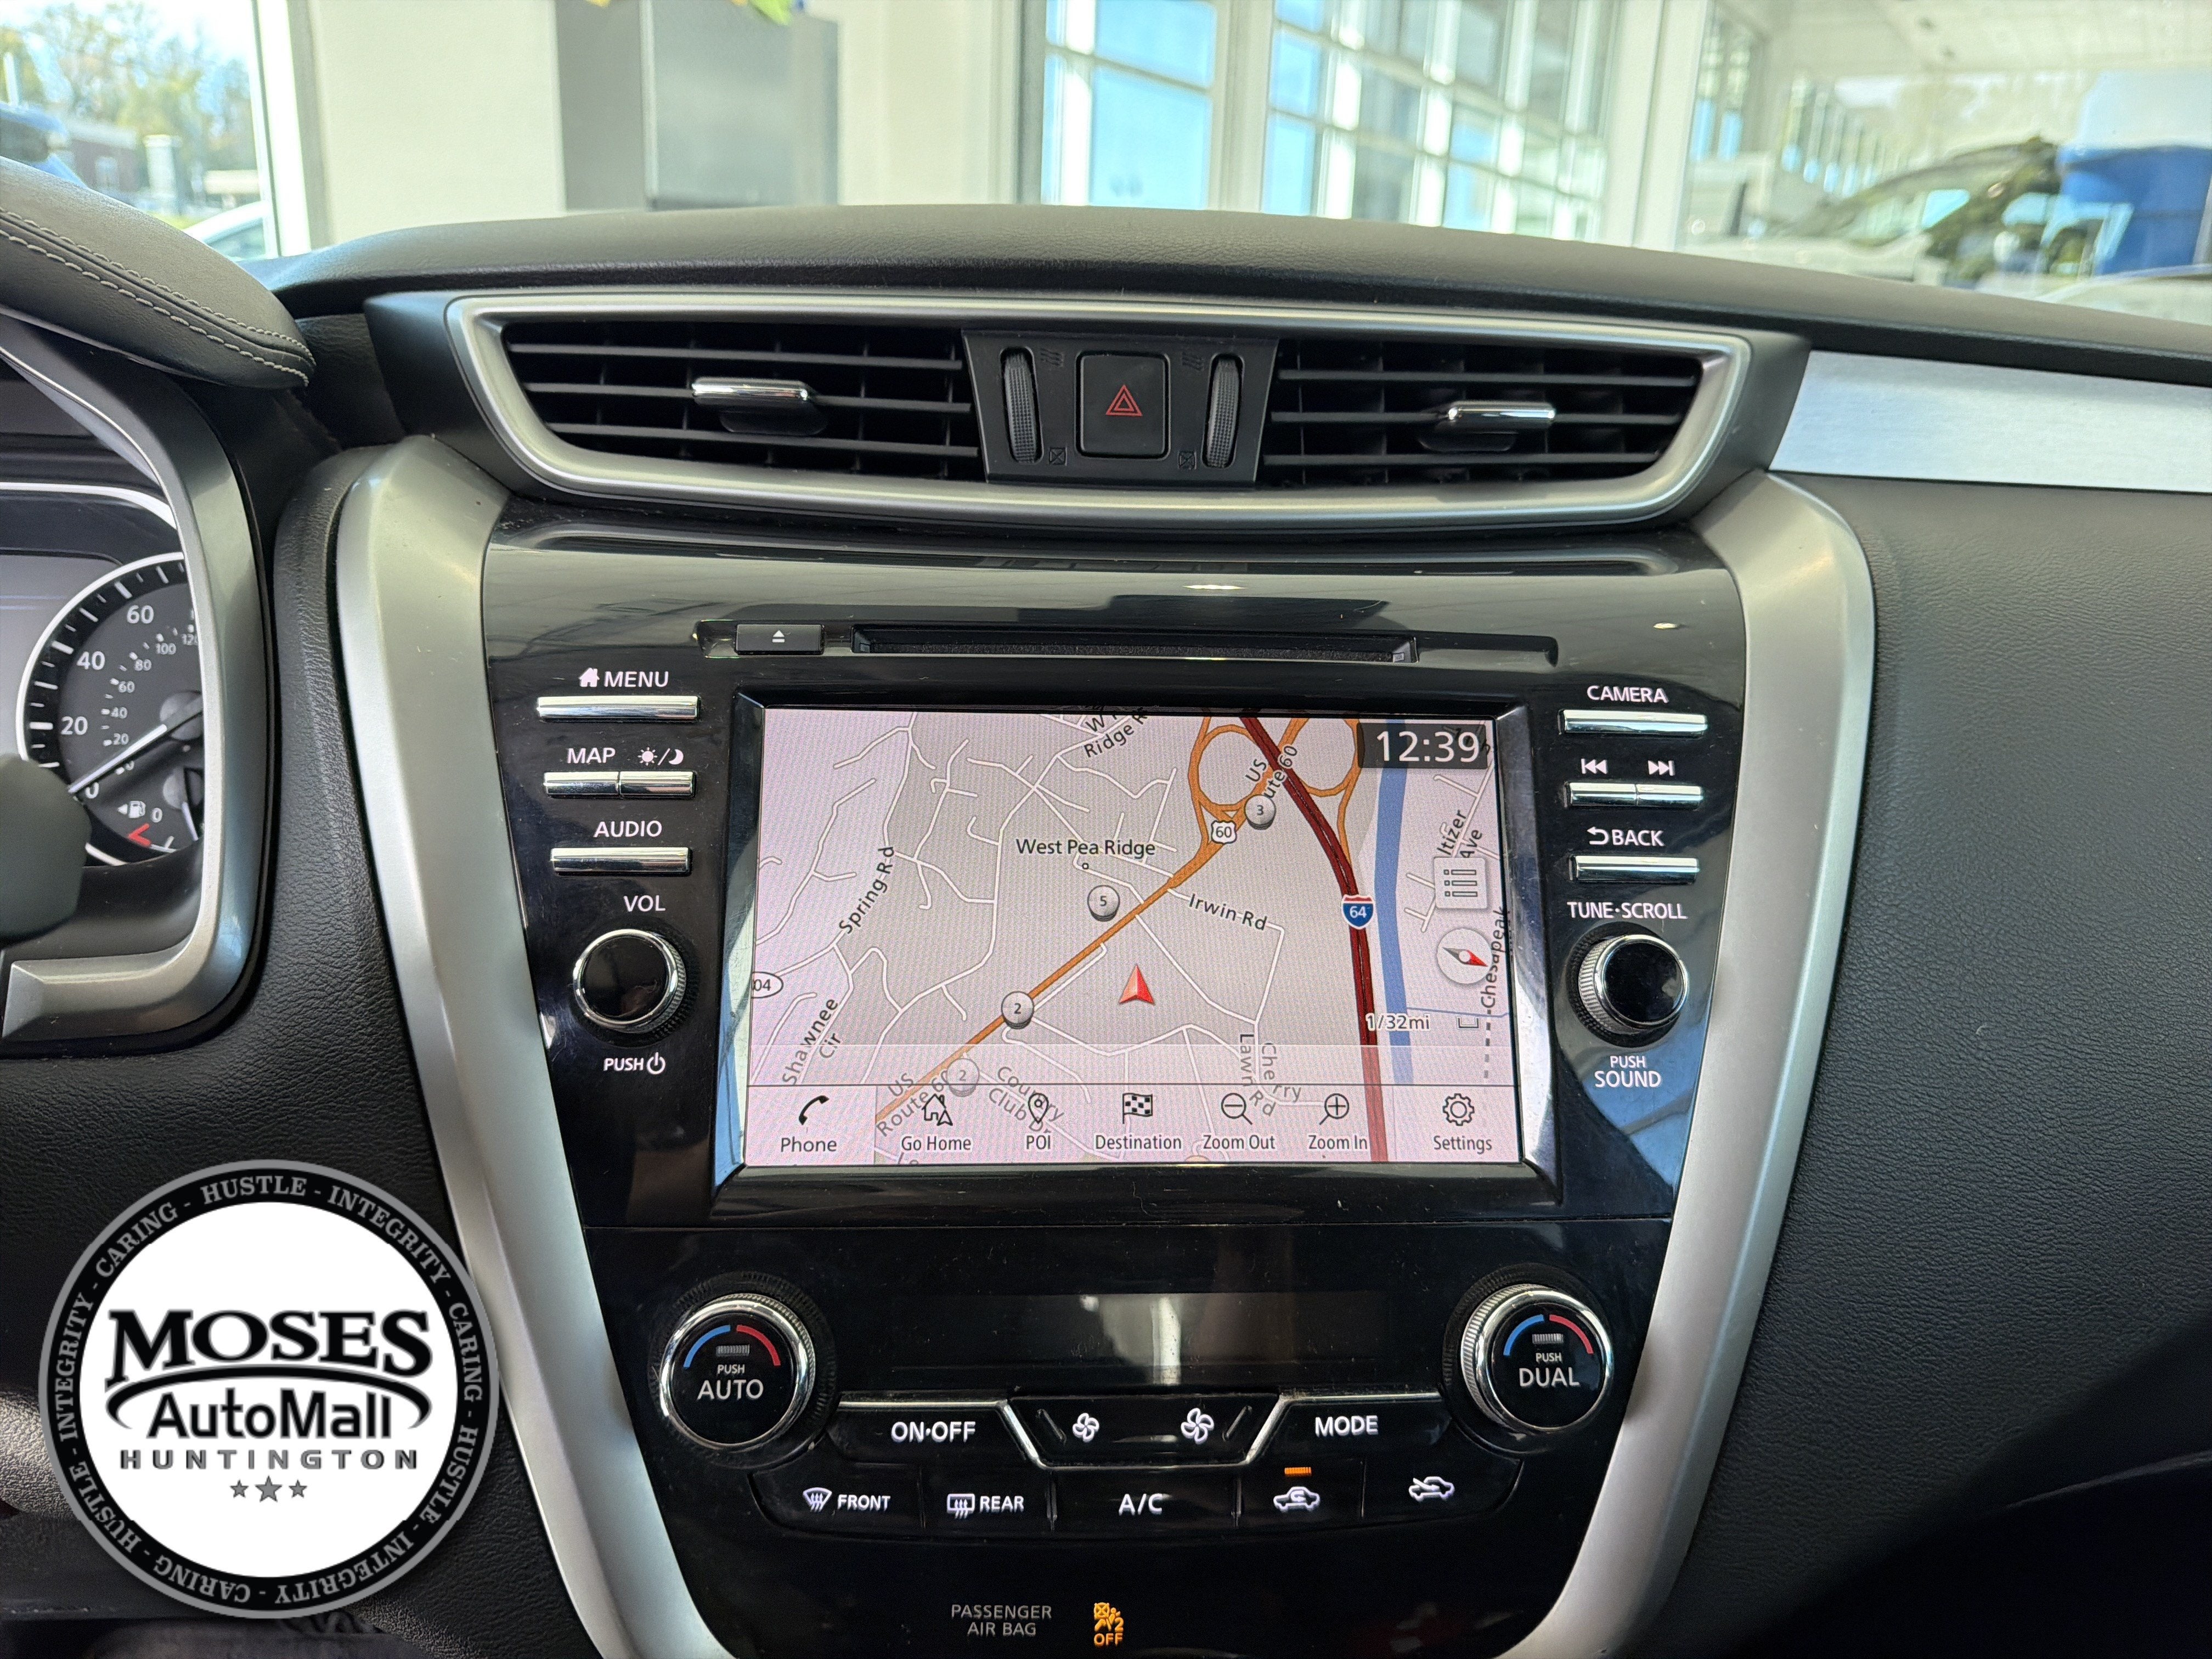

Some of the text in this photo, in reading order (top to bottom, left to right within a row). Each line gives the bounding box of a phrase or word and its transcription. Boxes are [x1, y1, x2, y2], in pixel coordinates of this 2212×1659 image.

[127, 605, 154, 624] 60
[156, 643, 176, 655] 100
[77, 651, 105, 670] 40
[134, 659, 151, 671] 80
[118, 681, 135, 693] 60
[605, 671, 669, 688] MENU
[1587, 686, 1668, 703] CAMERA
[111, 707, 127, 719] 40
[61, 716, 88, 735] 20
[113, 733, 129, 745] 20
[1084, 724, 1134, 758] Ridge
[1376, 731, 1480, 763] 12:39
[567, 748, 616, 764] MAP
[1245, 758, 1267, 782] US
[1263, 746, 1297, 798] ute 60
[152, 808, 162, 822] 0
[1257, 805, 1264, 816] 3
[594, 821, 662, 838] AUDIO
[1216, 826, 1232, 838] 60
[1460, 830, 1482, 858] Ave
[1612, 830, 1664, 846] BACK
[1016, 839, 1155, 859] West Pea Ridge
[839, 846, 894, 933] Spring Rd
[624, 895, 666, 912] VOL
[1099, 895, 1107, 906] 5
[1189, 893, 1267, 931] Irwin Rd
[1349, 906, 1367, 918] 64
[1014, 1003, 1021, 1014] 2
[782, 999, 838, 1085] Shawnee
[819, 1033, 840, 1058] Cir
[603, 1057, 644, 1071] PUSH
[1610, 1056, 1645, 1068] PUSH
[1240, 1034, 1276, 1116] Lawn Rd
[1594, 1071, 1661, 1087] SOUND
[888, 1073, 913, 1096] US
[989, 1088, 1026, 1120] Club
[877, 1092, 928, 1136] Route
[781, 1137, 837, 1153] Phone
[901, 1136, 971, 1150] Go Home
[1026, 1135, 1051, 1149] POI
[1096, 1135, 1182, 1150] Destination
[1203, 1134, 1275, 1149] Zoom Out
[1308, 1136, 1367, 1149] Zoom In
[1433, 1136, 1492, 1153] Settings
[1536, 1352, 1562, 1363] PUSH
[717, 1364, 745, 1374] PUSH
[1520, 1368, 1579, 1387] DUAL
[697, 1379, 763, 1400] AUTO
[1316, 1415, 1378, 1435] MODE
[838, 1494, 890, 1511] FRONT
[980, 1496, 1024, 1511] REAR
[1119, 1494, 1163, 1515] A/C
[951, 1604, 1052, 1620] PASSENGER
[968, 1622, 1036, 1637] AIR BAG
[1094, 1633, 1122, 1646] OFF
